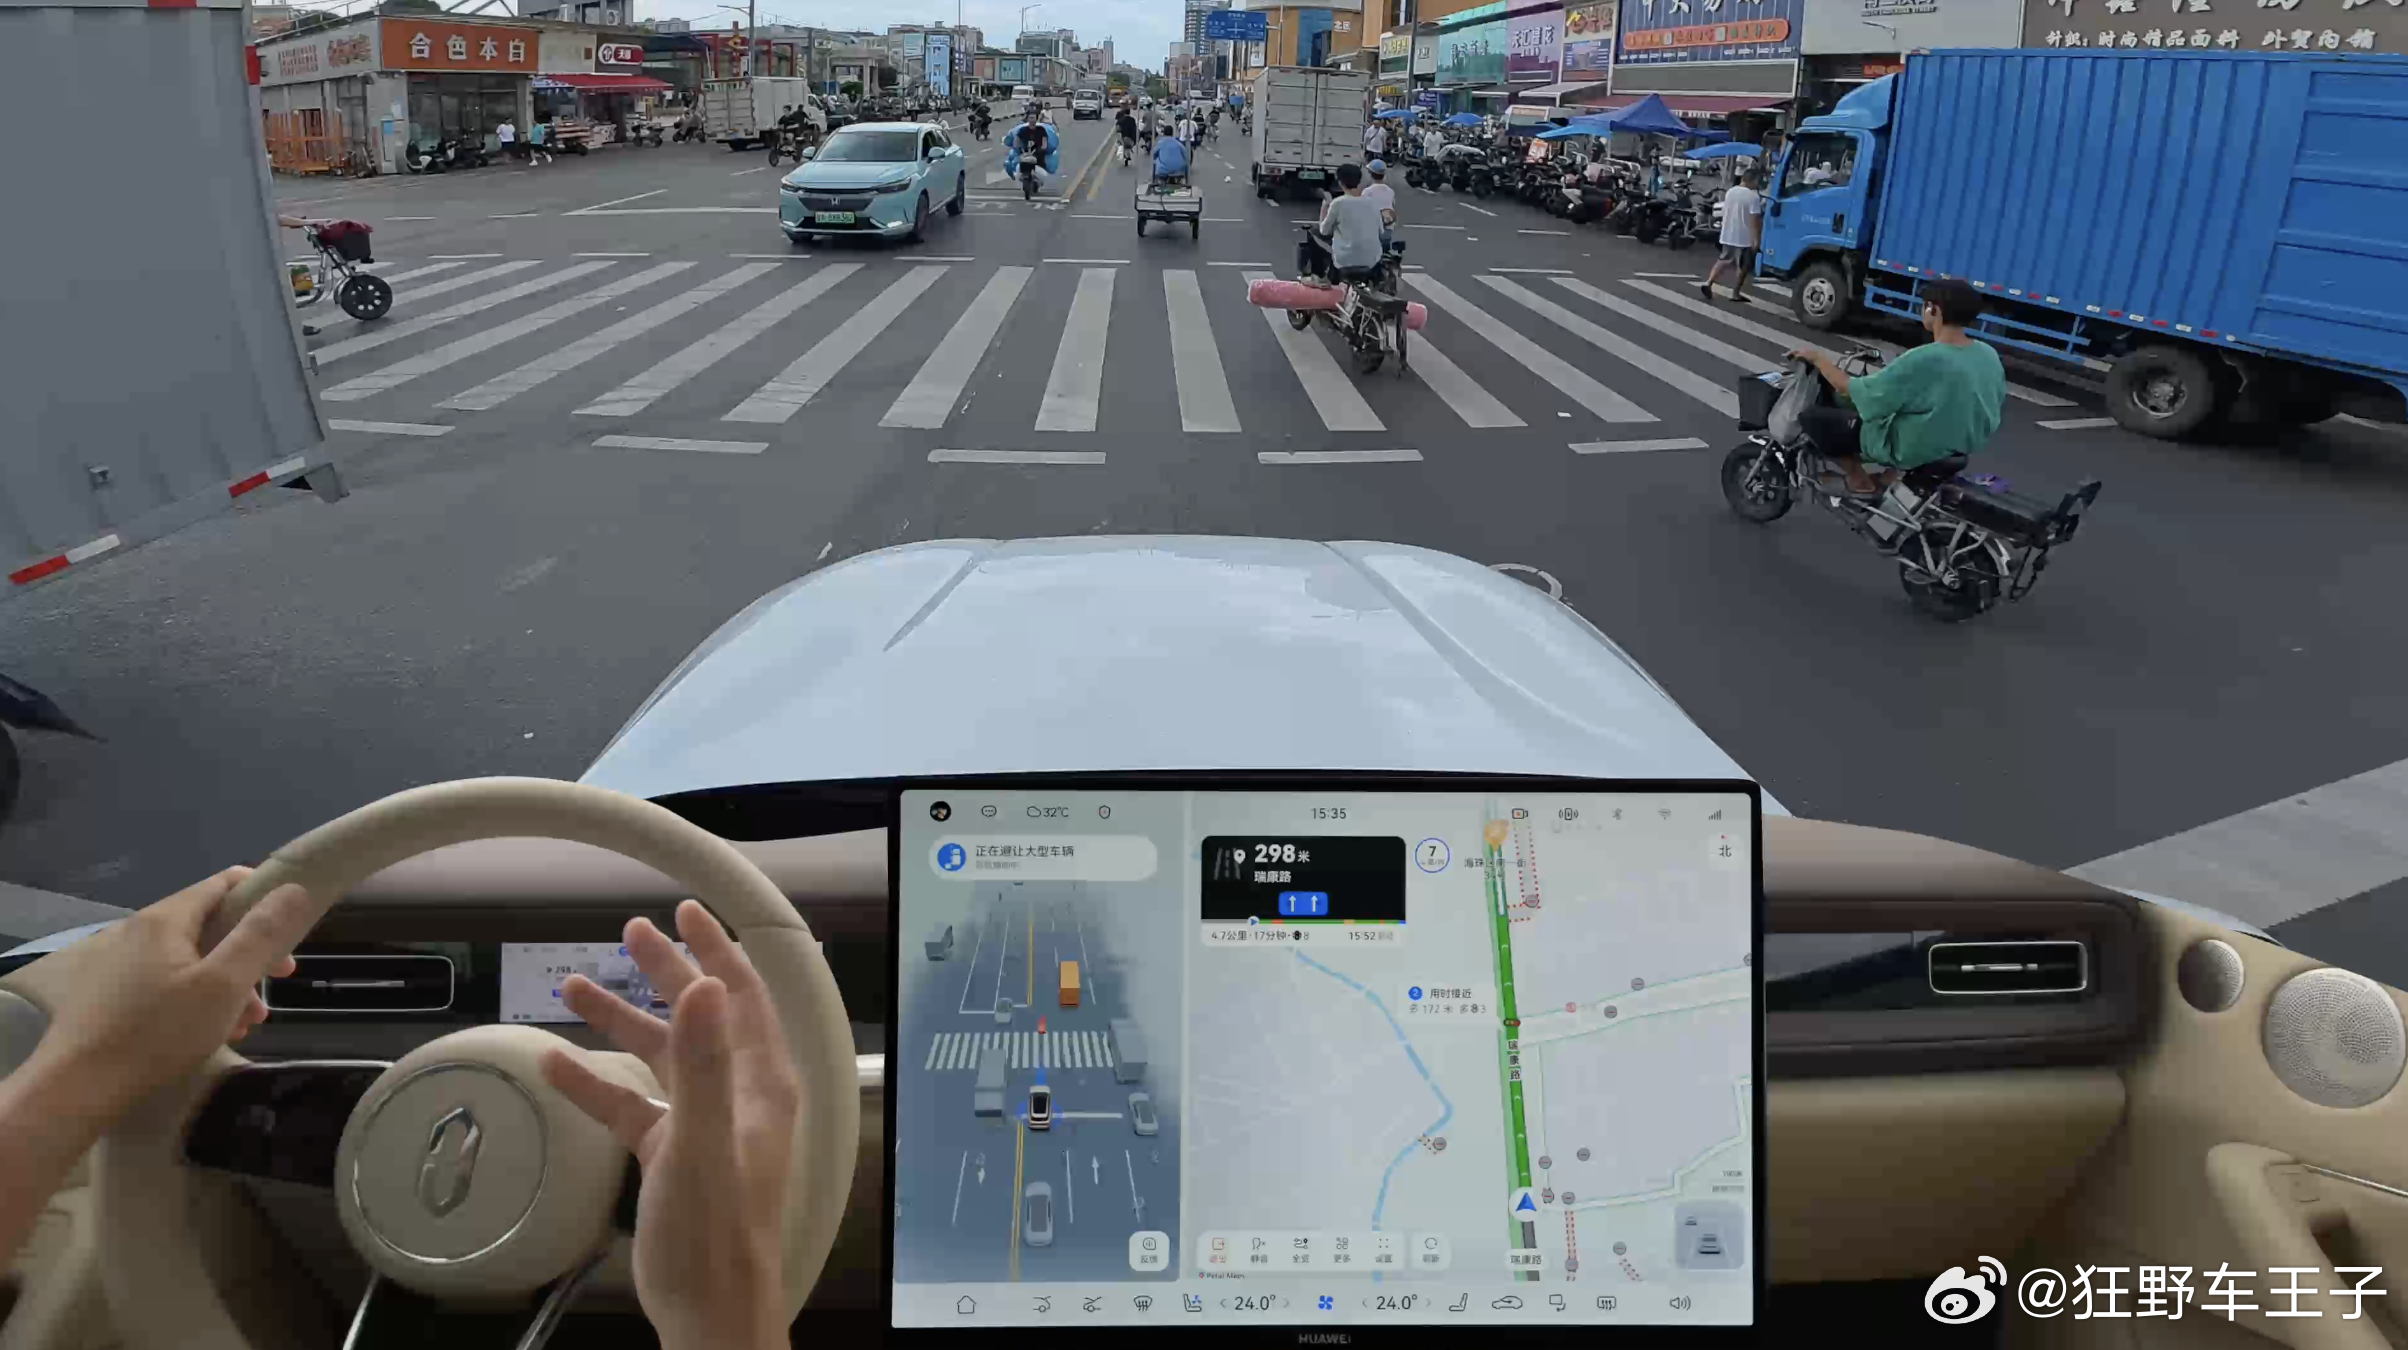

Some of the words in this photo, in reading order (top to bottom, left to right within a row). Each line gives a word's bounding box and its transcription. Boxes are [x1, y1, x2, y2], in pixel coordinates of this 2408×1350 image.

[409, 32, 526, 63] 合色本白
[1311, 808, 1347, 819] 15:35
[976, 845, 1075, 858] 正在避让大型车辆
[1428, 846, 1436, 857] 7
[1719, 845, 1731, 857] 北
[1254, 871, 1292, 883] 瑞康路
[1430, 988, 1472, 999] 用时接近
[1299, 1334, 1351, 1344] HUAWEI
